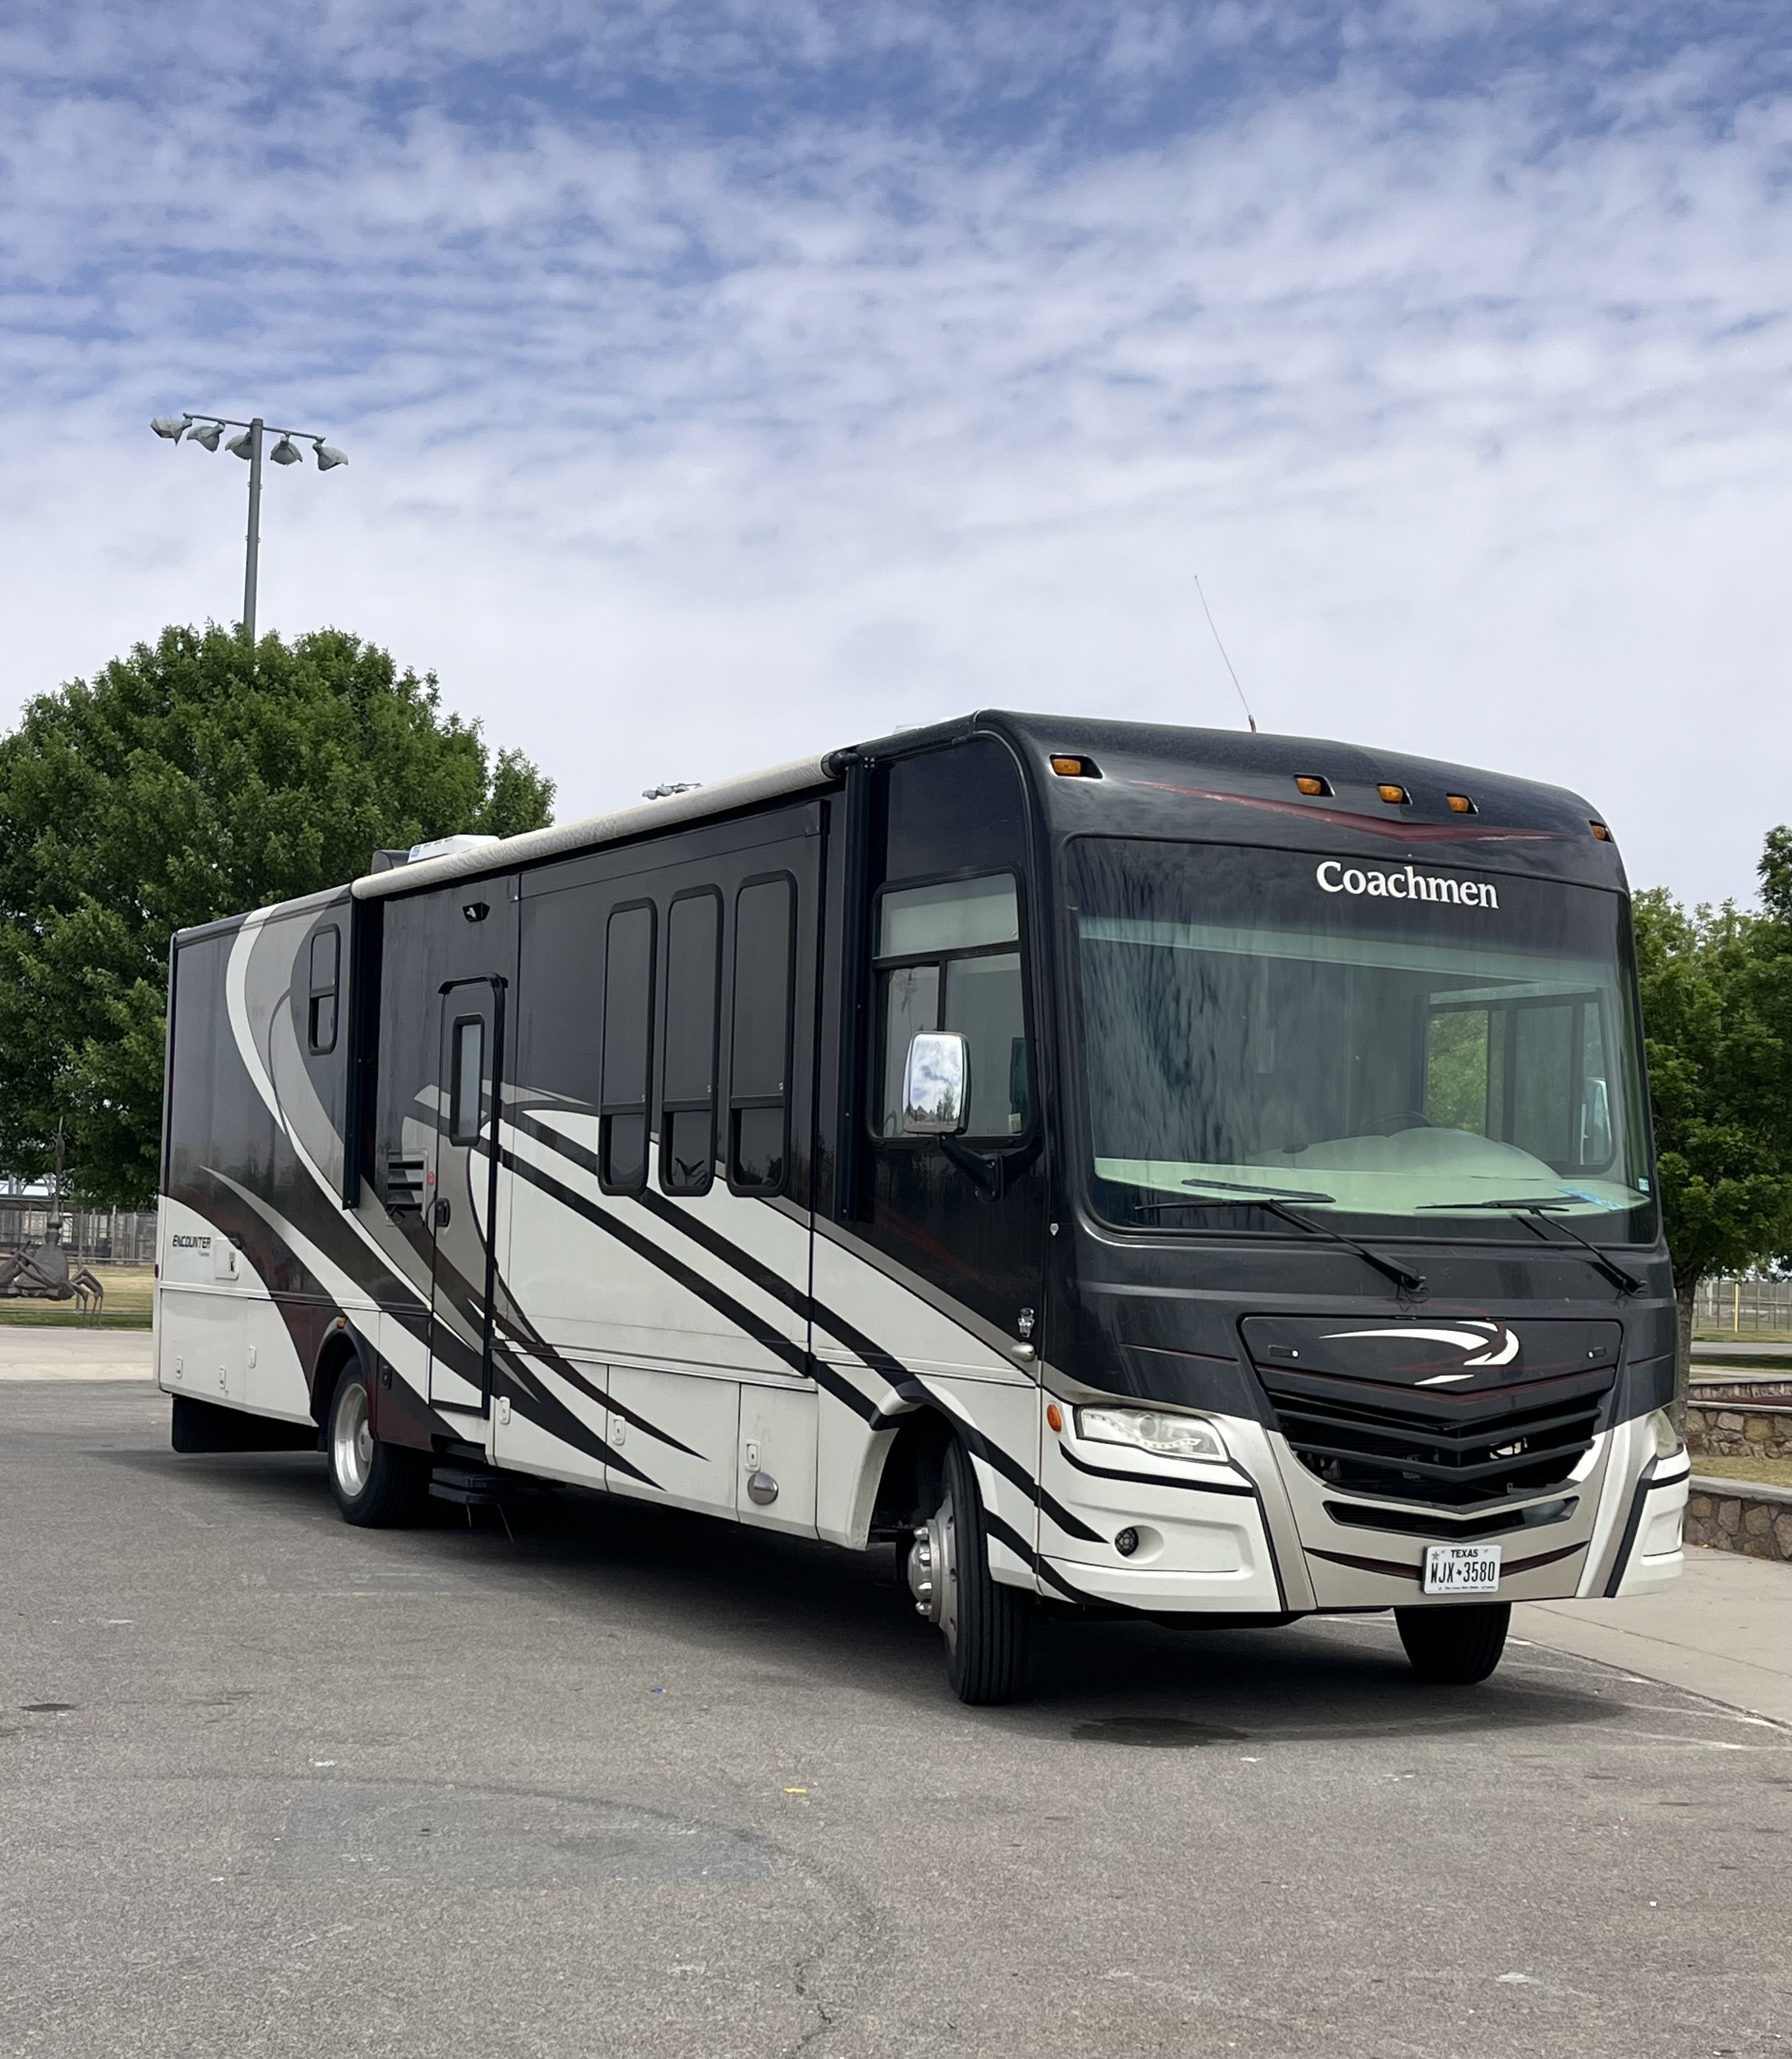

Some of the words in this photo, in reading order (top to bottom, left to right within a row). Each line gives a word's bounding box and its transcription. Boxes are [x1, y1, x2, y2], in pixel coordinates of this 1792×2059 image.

[1316, 861, 1500, 909] Coachmen
[172, 1235, 211, 1249] ENCOUNTER
[1451, 1549, 1479, 1558] TEXAS
[1463, 1561, 1495, 1582] 3580
